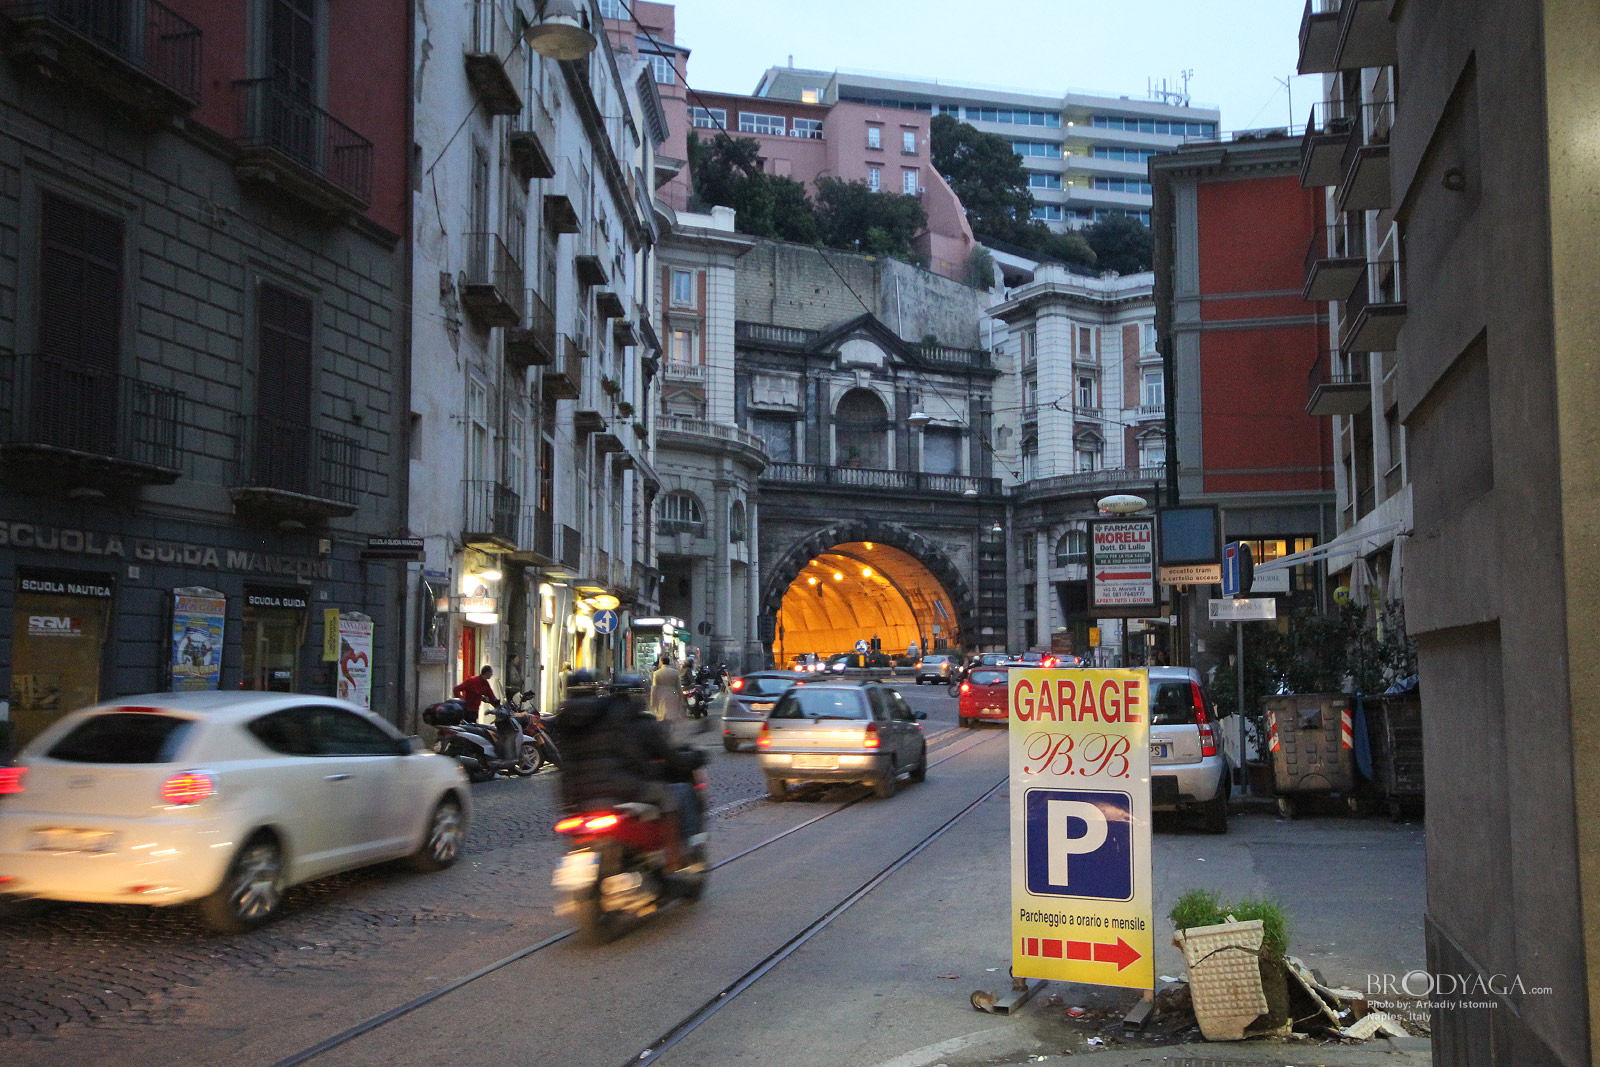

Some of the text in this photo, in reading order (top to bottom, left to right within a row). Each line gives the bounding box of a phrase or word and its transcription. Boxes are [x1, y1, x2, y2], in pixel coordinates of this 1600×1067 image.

[1104, 524, 1149, 532] FARMACIA
[1095, 531, 1151, 544] MORELLI
[135, 537, 219, 567] GUIDA
[22, 579, 111, 597] SCUOLA NAUTICA
[249, 595, 306, 608] SCUOLA GUIDA
[463, 599, 496, 607] YAMAHA
[28, 616, 71, 629] SGM
[1014, 679, 1142, 723] GARAGE
[1047, 800, 1109, 887] P
[1020, 908, 1145, 931] Parcheggio a orario e mensile
